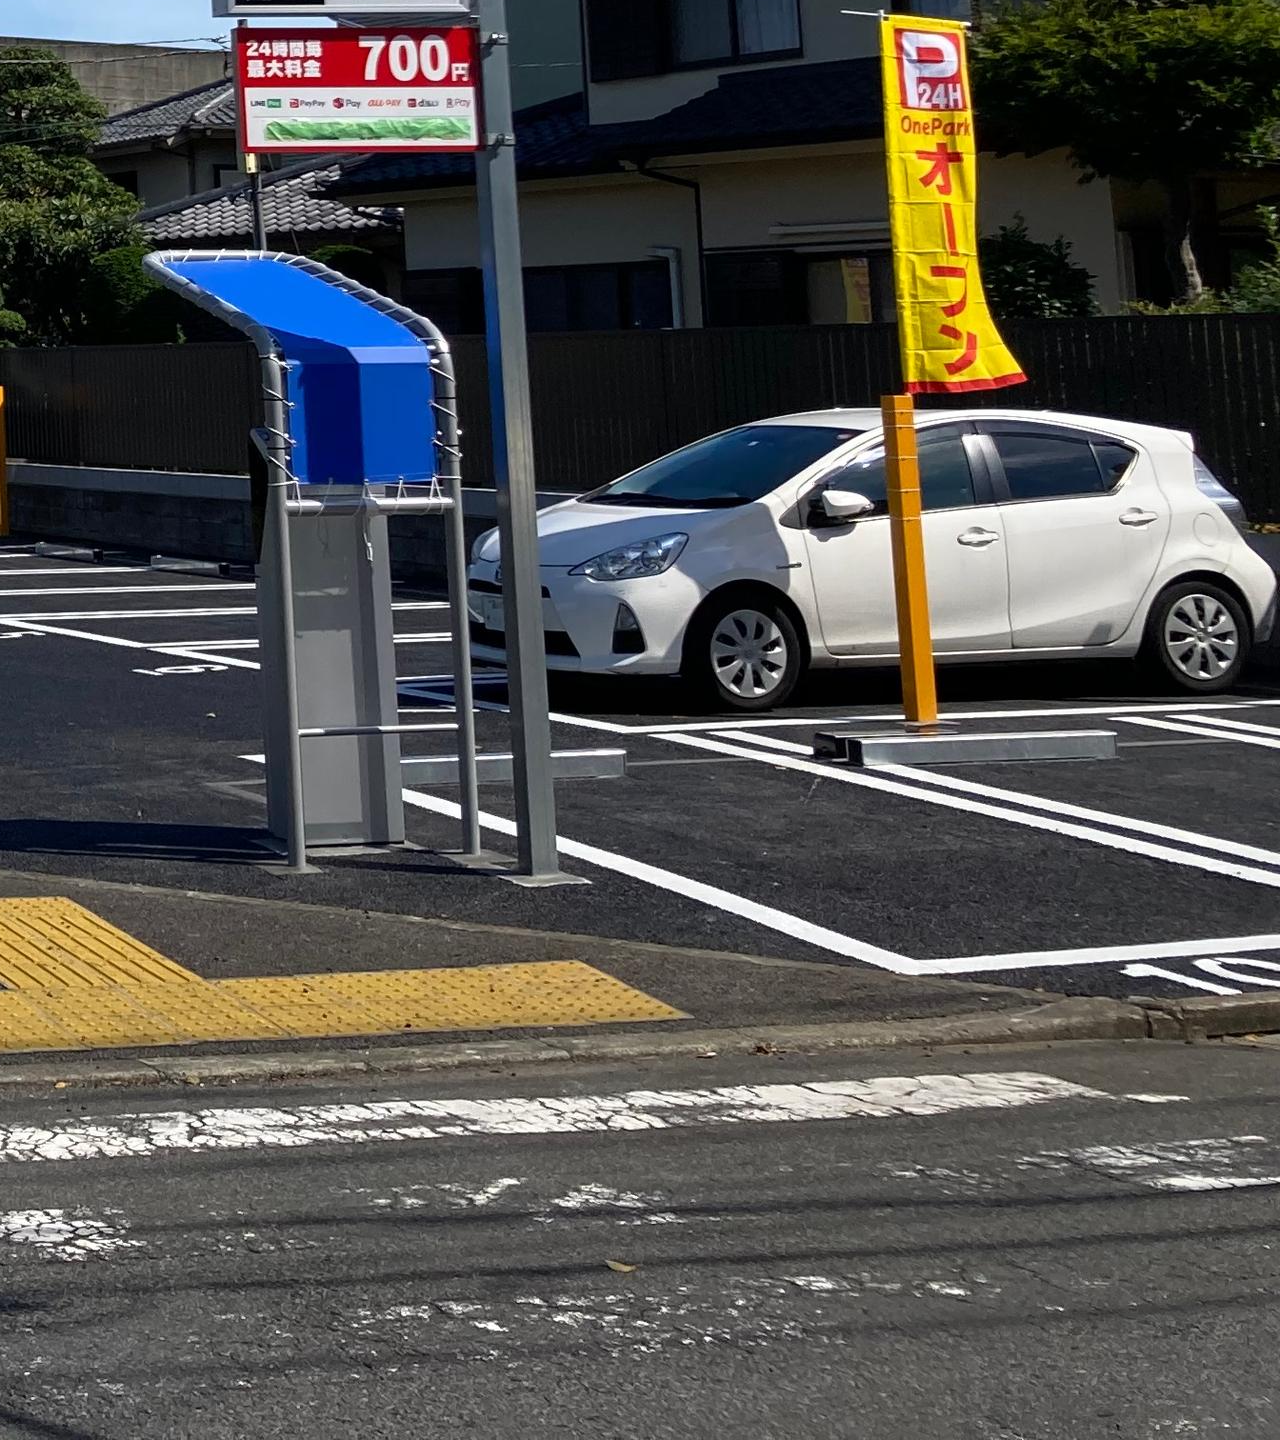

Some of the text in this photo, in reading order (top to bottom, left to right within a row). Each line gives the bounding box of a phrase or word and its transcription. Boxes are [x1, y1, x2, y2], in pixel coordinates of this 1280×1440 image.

[245, 59, 322, 79] 最大料金
[300, 99, 325, 108] PayPay
[917, 81, 963, 109] 24H
[900, 114, 971, 137] OnePark
